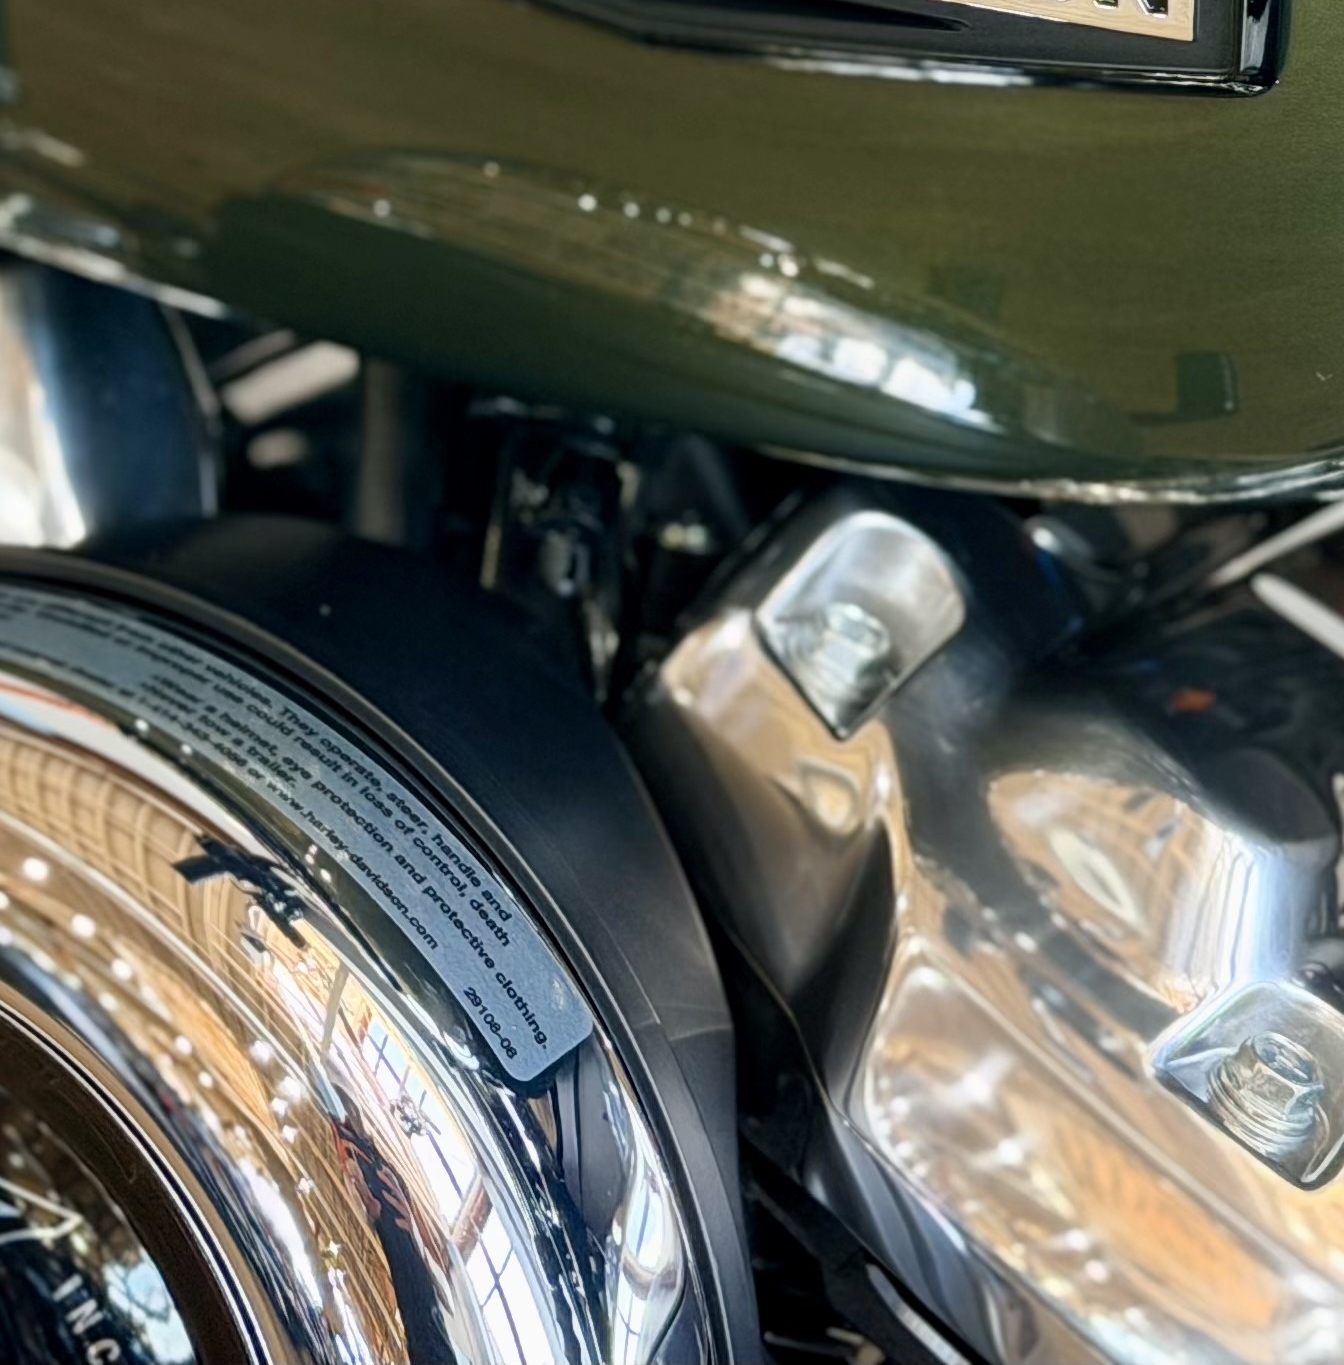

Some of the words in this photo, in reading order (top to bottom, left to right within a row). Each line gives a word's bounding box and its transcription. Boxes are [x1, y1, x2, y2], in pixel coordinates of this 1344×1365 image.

[196, 711, 233, 738] tow
[230, 734, 245, 748] a
[246, 744, 296, 789] trailer.
[203, 664, 275, 709] vehicles.
[278, 704, 320, 739] They
[318, 734, 384, 793] operate,
[385, 791, 431, 835] steer,
[430, 831, 484, 889] handle
[479, 887, 513, 922] and
[211, 682, 244, 705] use
[245, 703, 294, 737] could
[293, 733, 343, 773] result
[340, 770, 360, 788] in
[358, 784, 395, 819] loss
[393, 817, 416, 837] of
[411, 835, 470, 899] control,
[467, 895, 513, 947] death
[218, 709, 280, 757] helmet,
[279, 753, 314, 782] eye
[310, 779, 396, 853] protection
[392, 851, 427, 886] and
[421, 883, 498, 970] protective
[493, 969, 552, 1049] clothing.
[246, 765, 265, 783] or
[264, 780, 439, 951] www.harley-davidson.com
